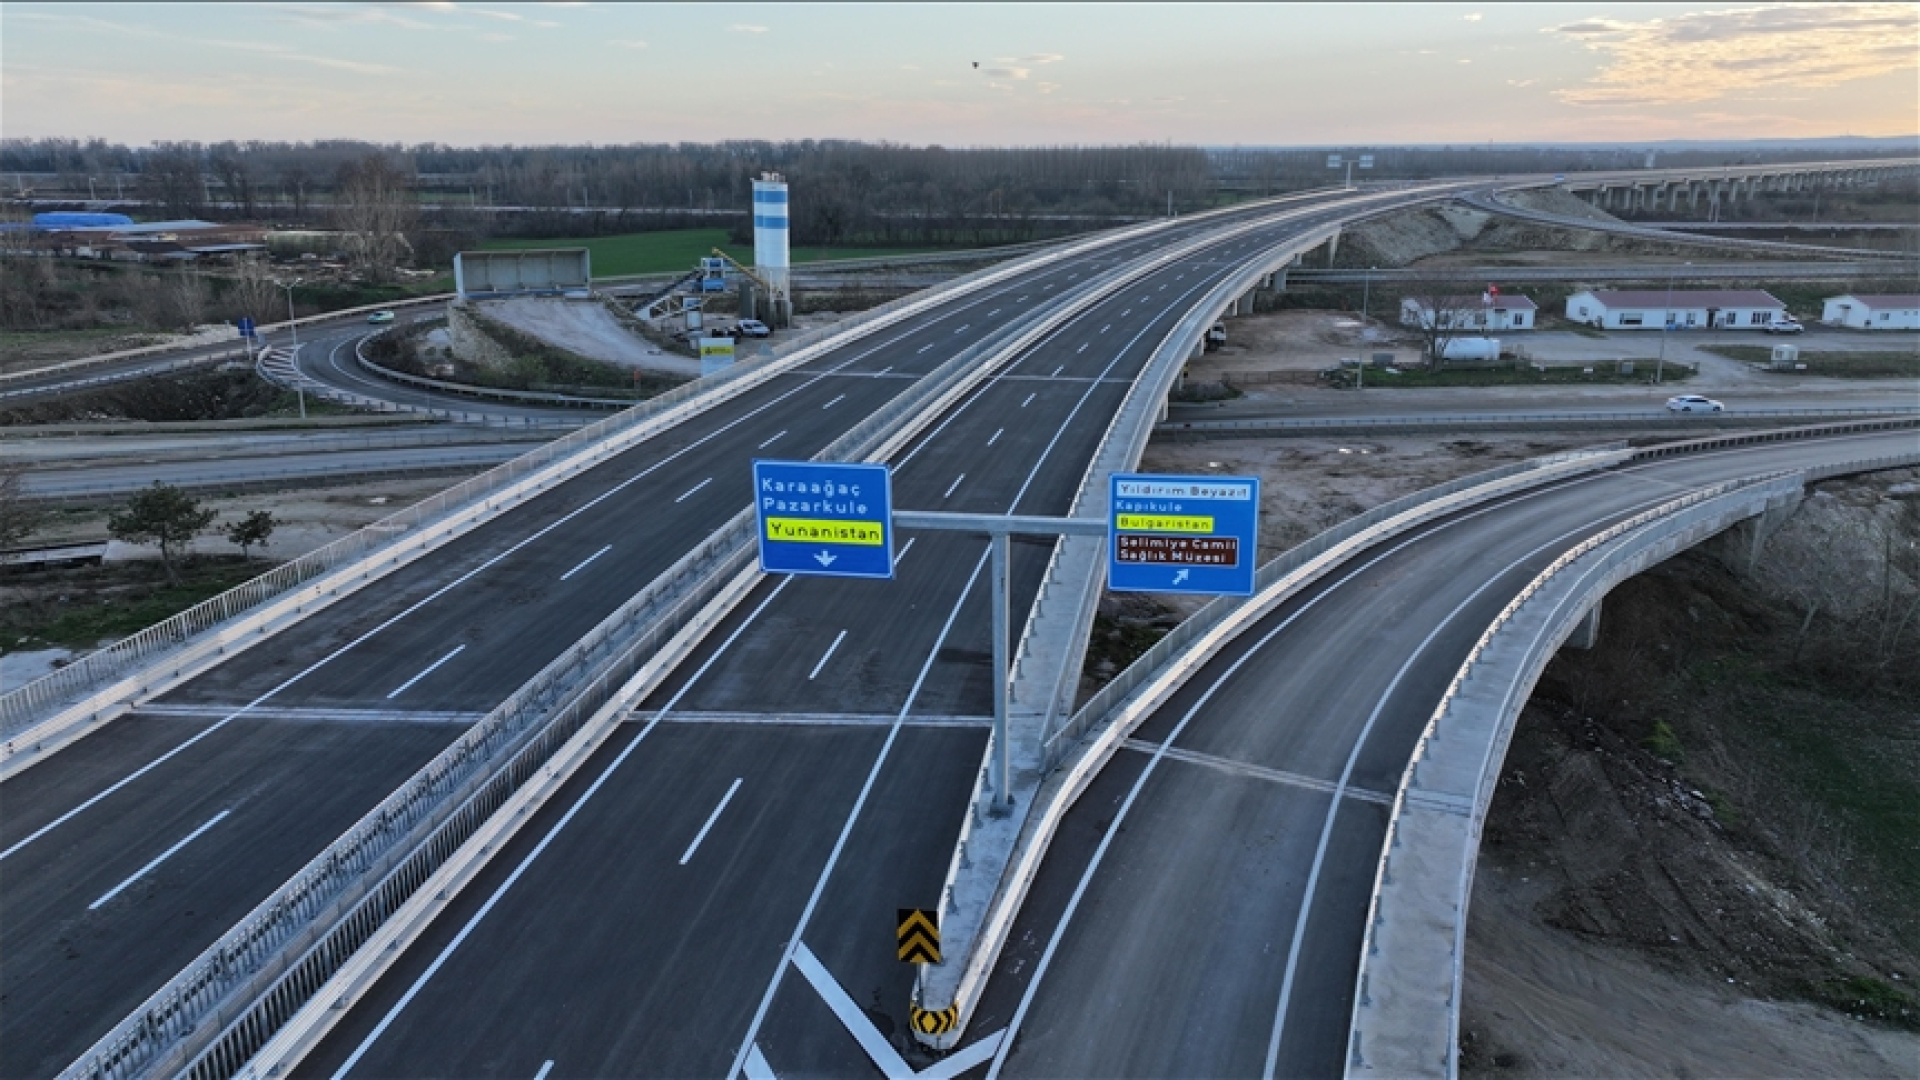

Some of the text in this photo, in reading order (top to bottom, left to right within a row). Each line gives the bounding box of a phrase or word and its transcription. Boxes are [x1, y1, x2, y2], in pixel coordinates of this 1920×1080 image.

[762, 477, 860, 497] Karaağaç
[763, 497, 868, 514] Pazarkule
[771, 522, 880, 541] Yunanistan
[1120, 517, 1209, 530] Bulgaristan
